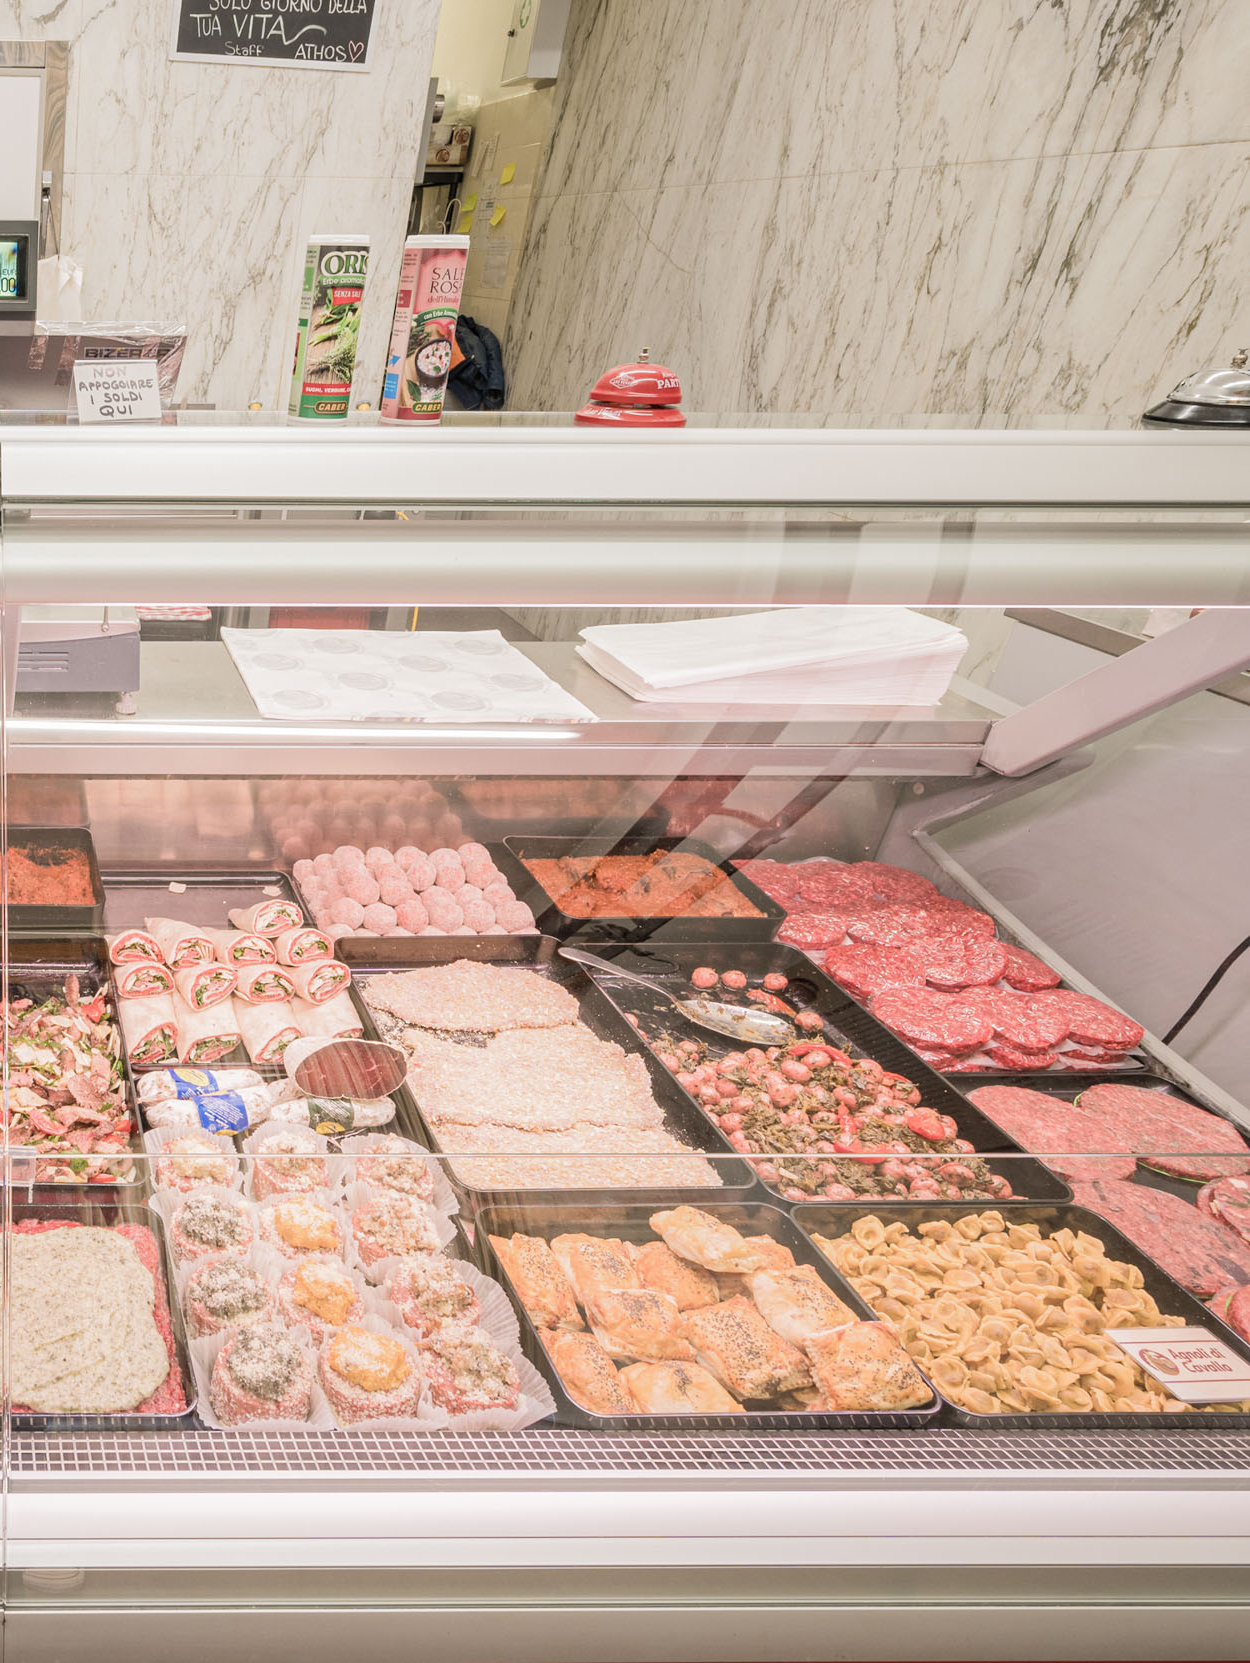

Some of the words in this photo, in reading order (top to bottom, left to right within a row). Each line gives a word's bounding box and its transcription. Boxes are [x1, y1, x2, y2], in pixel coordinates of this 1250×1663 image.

[261, 0, 322, 13] GIORNO
[328, 0, 368, 14] DELLA
[190, 14, 222, 38] TUA
[233, 14, 290, 45] VITA
[224, 41, 265, 57] Staff
[294, 43, 347, 62] ATHOS
[93, 366, 127, 379] NON
[78, 378, 154, 392] APPOGGIARE
[90, 395, 95, 405] I
[104, 391, 143, 403] SOLDI
[99, 404, 133, 418] QUI
[318, 403, 346, 411] CABER
[415, 403, 441, 411] CABER
[1166, 1347, 1210, 1363] Agnoli
[1210, 1347, 1226, 1359] di
[1181, 1361, 1233, 1373] Cavallo
